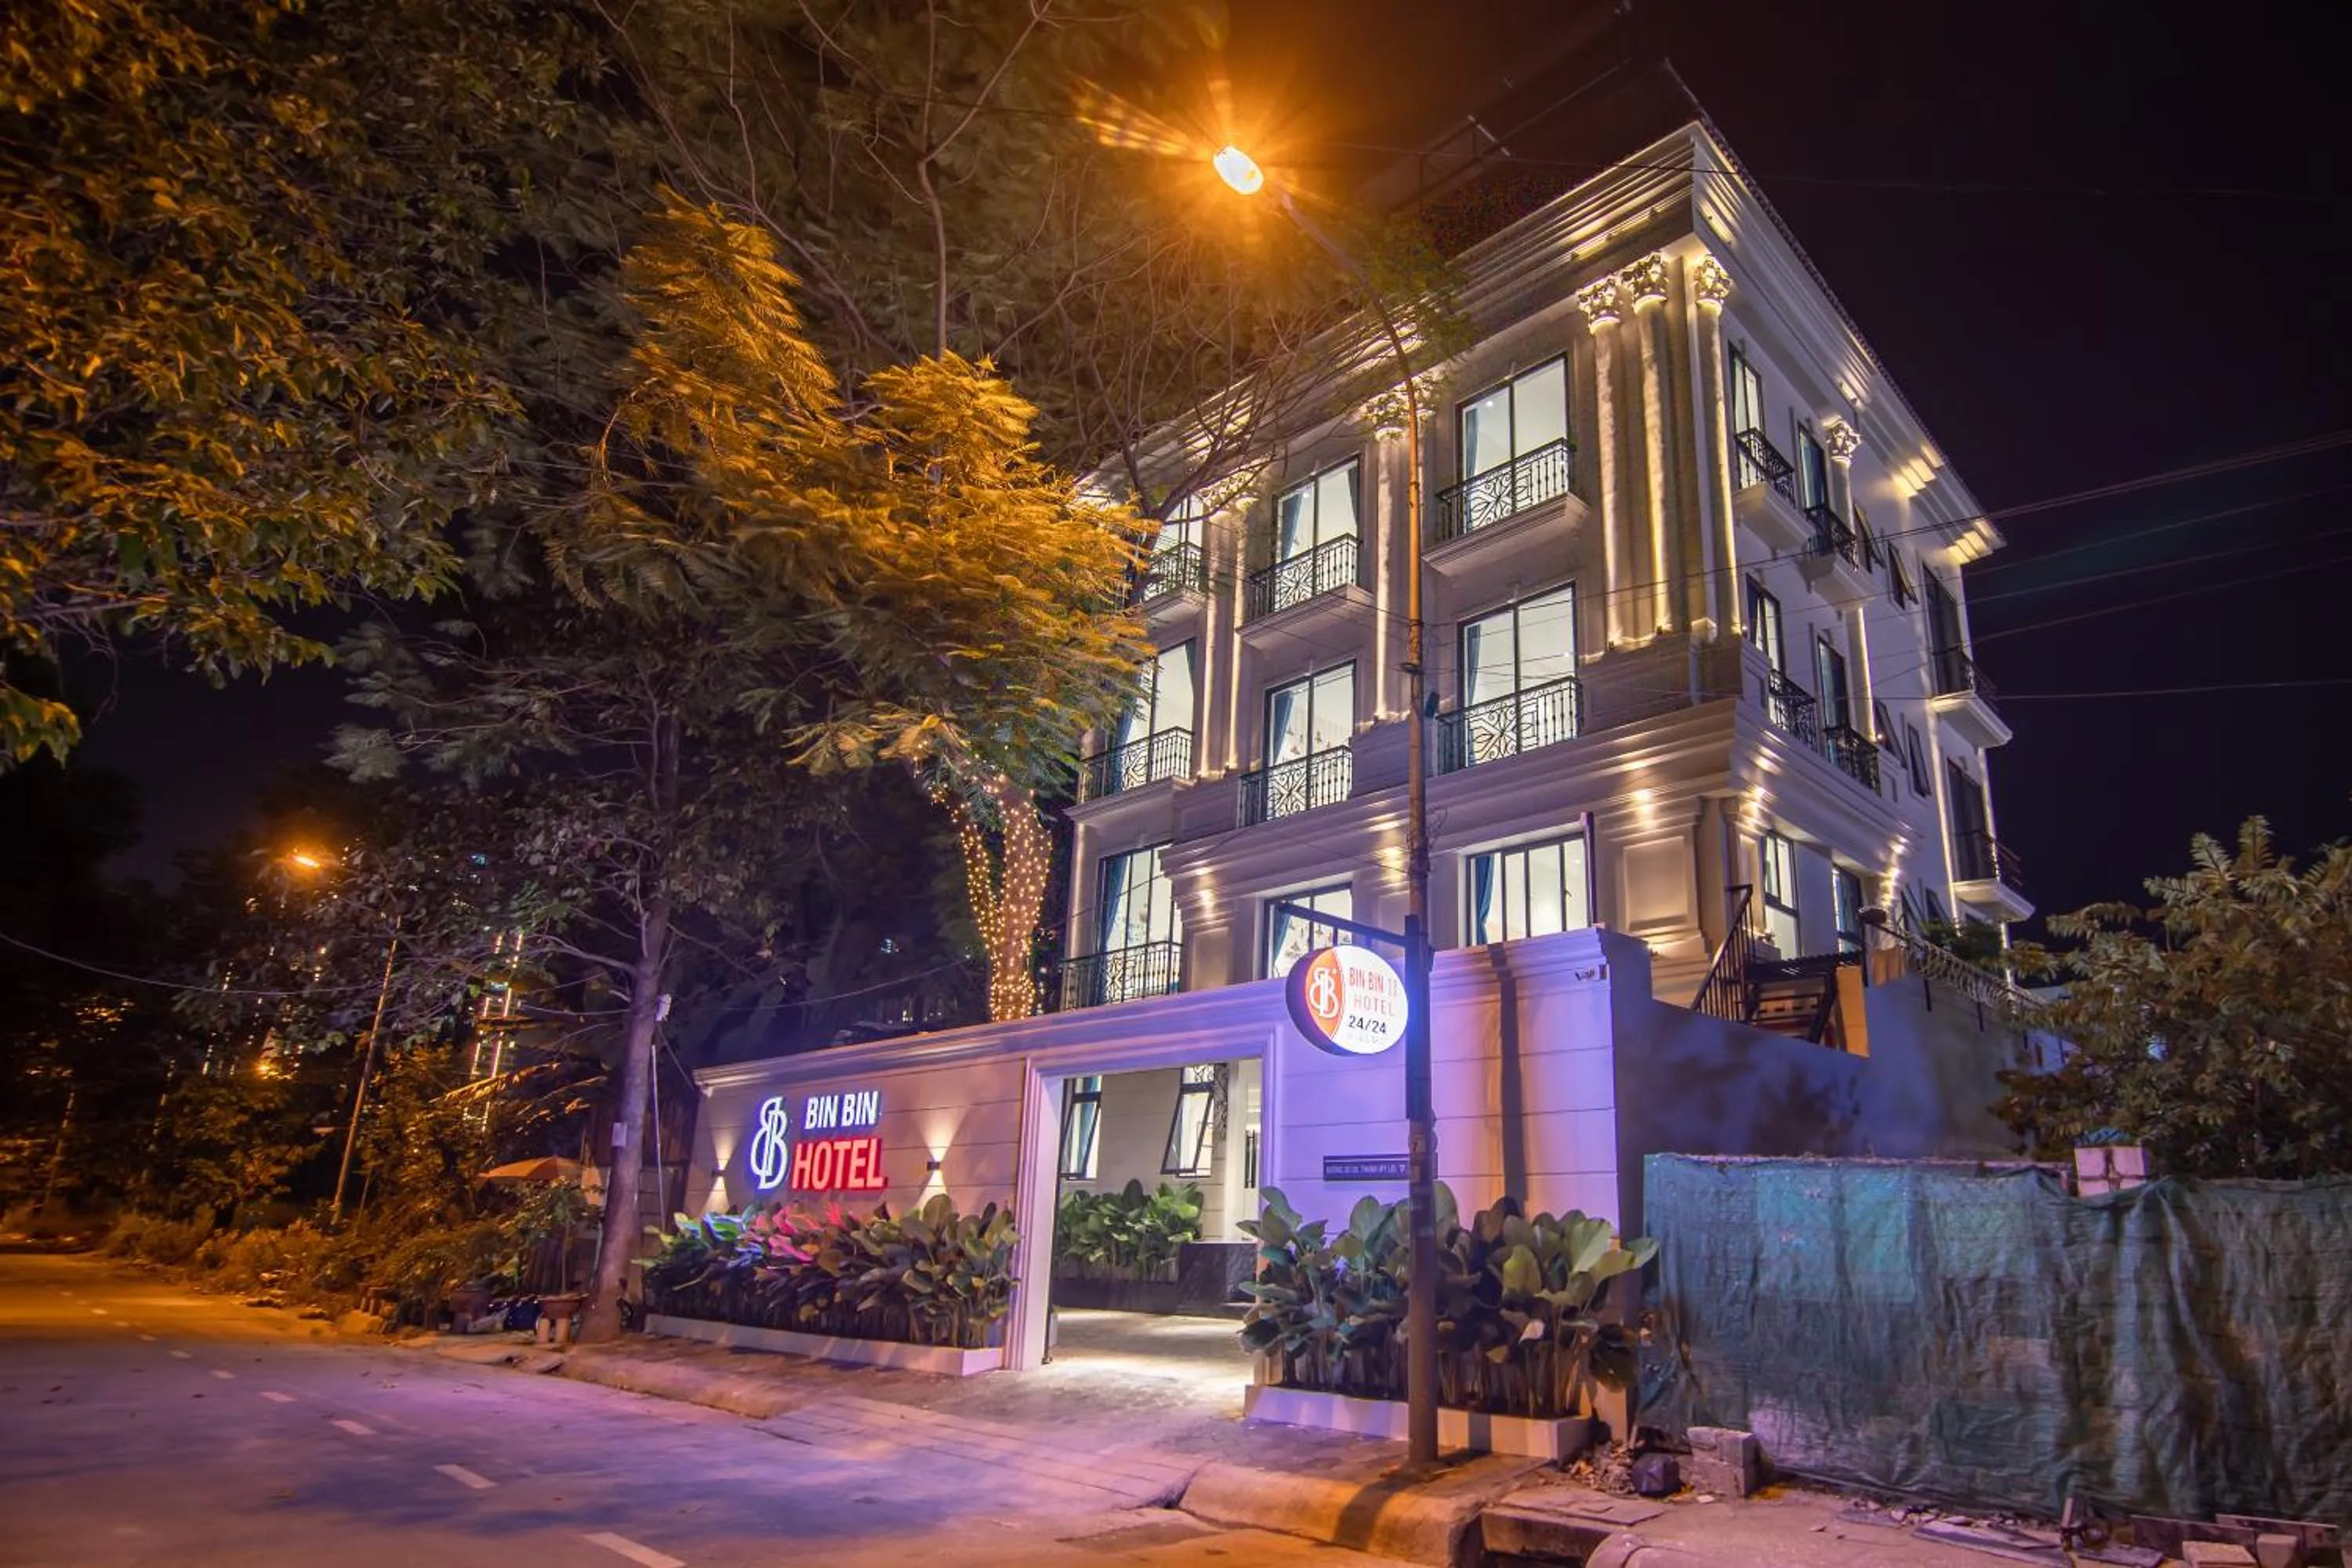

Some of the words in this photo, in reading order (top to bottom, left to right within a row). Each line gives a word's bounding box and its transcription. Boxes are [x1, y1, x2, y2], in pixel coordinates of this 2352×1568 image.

[1348, 967, 1365, 990] BIN
[1368, 971, 1385, 994] BIN
[1353, 993, 1396, 1017] HOTEL
[1348, 1014, 1387, 1035] 24/24
[804, 1094, 840, 1130] BIN
[841, 1091, 879, 1127] BIN
[790, 1137, 885, 1191] HOTEL
